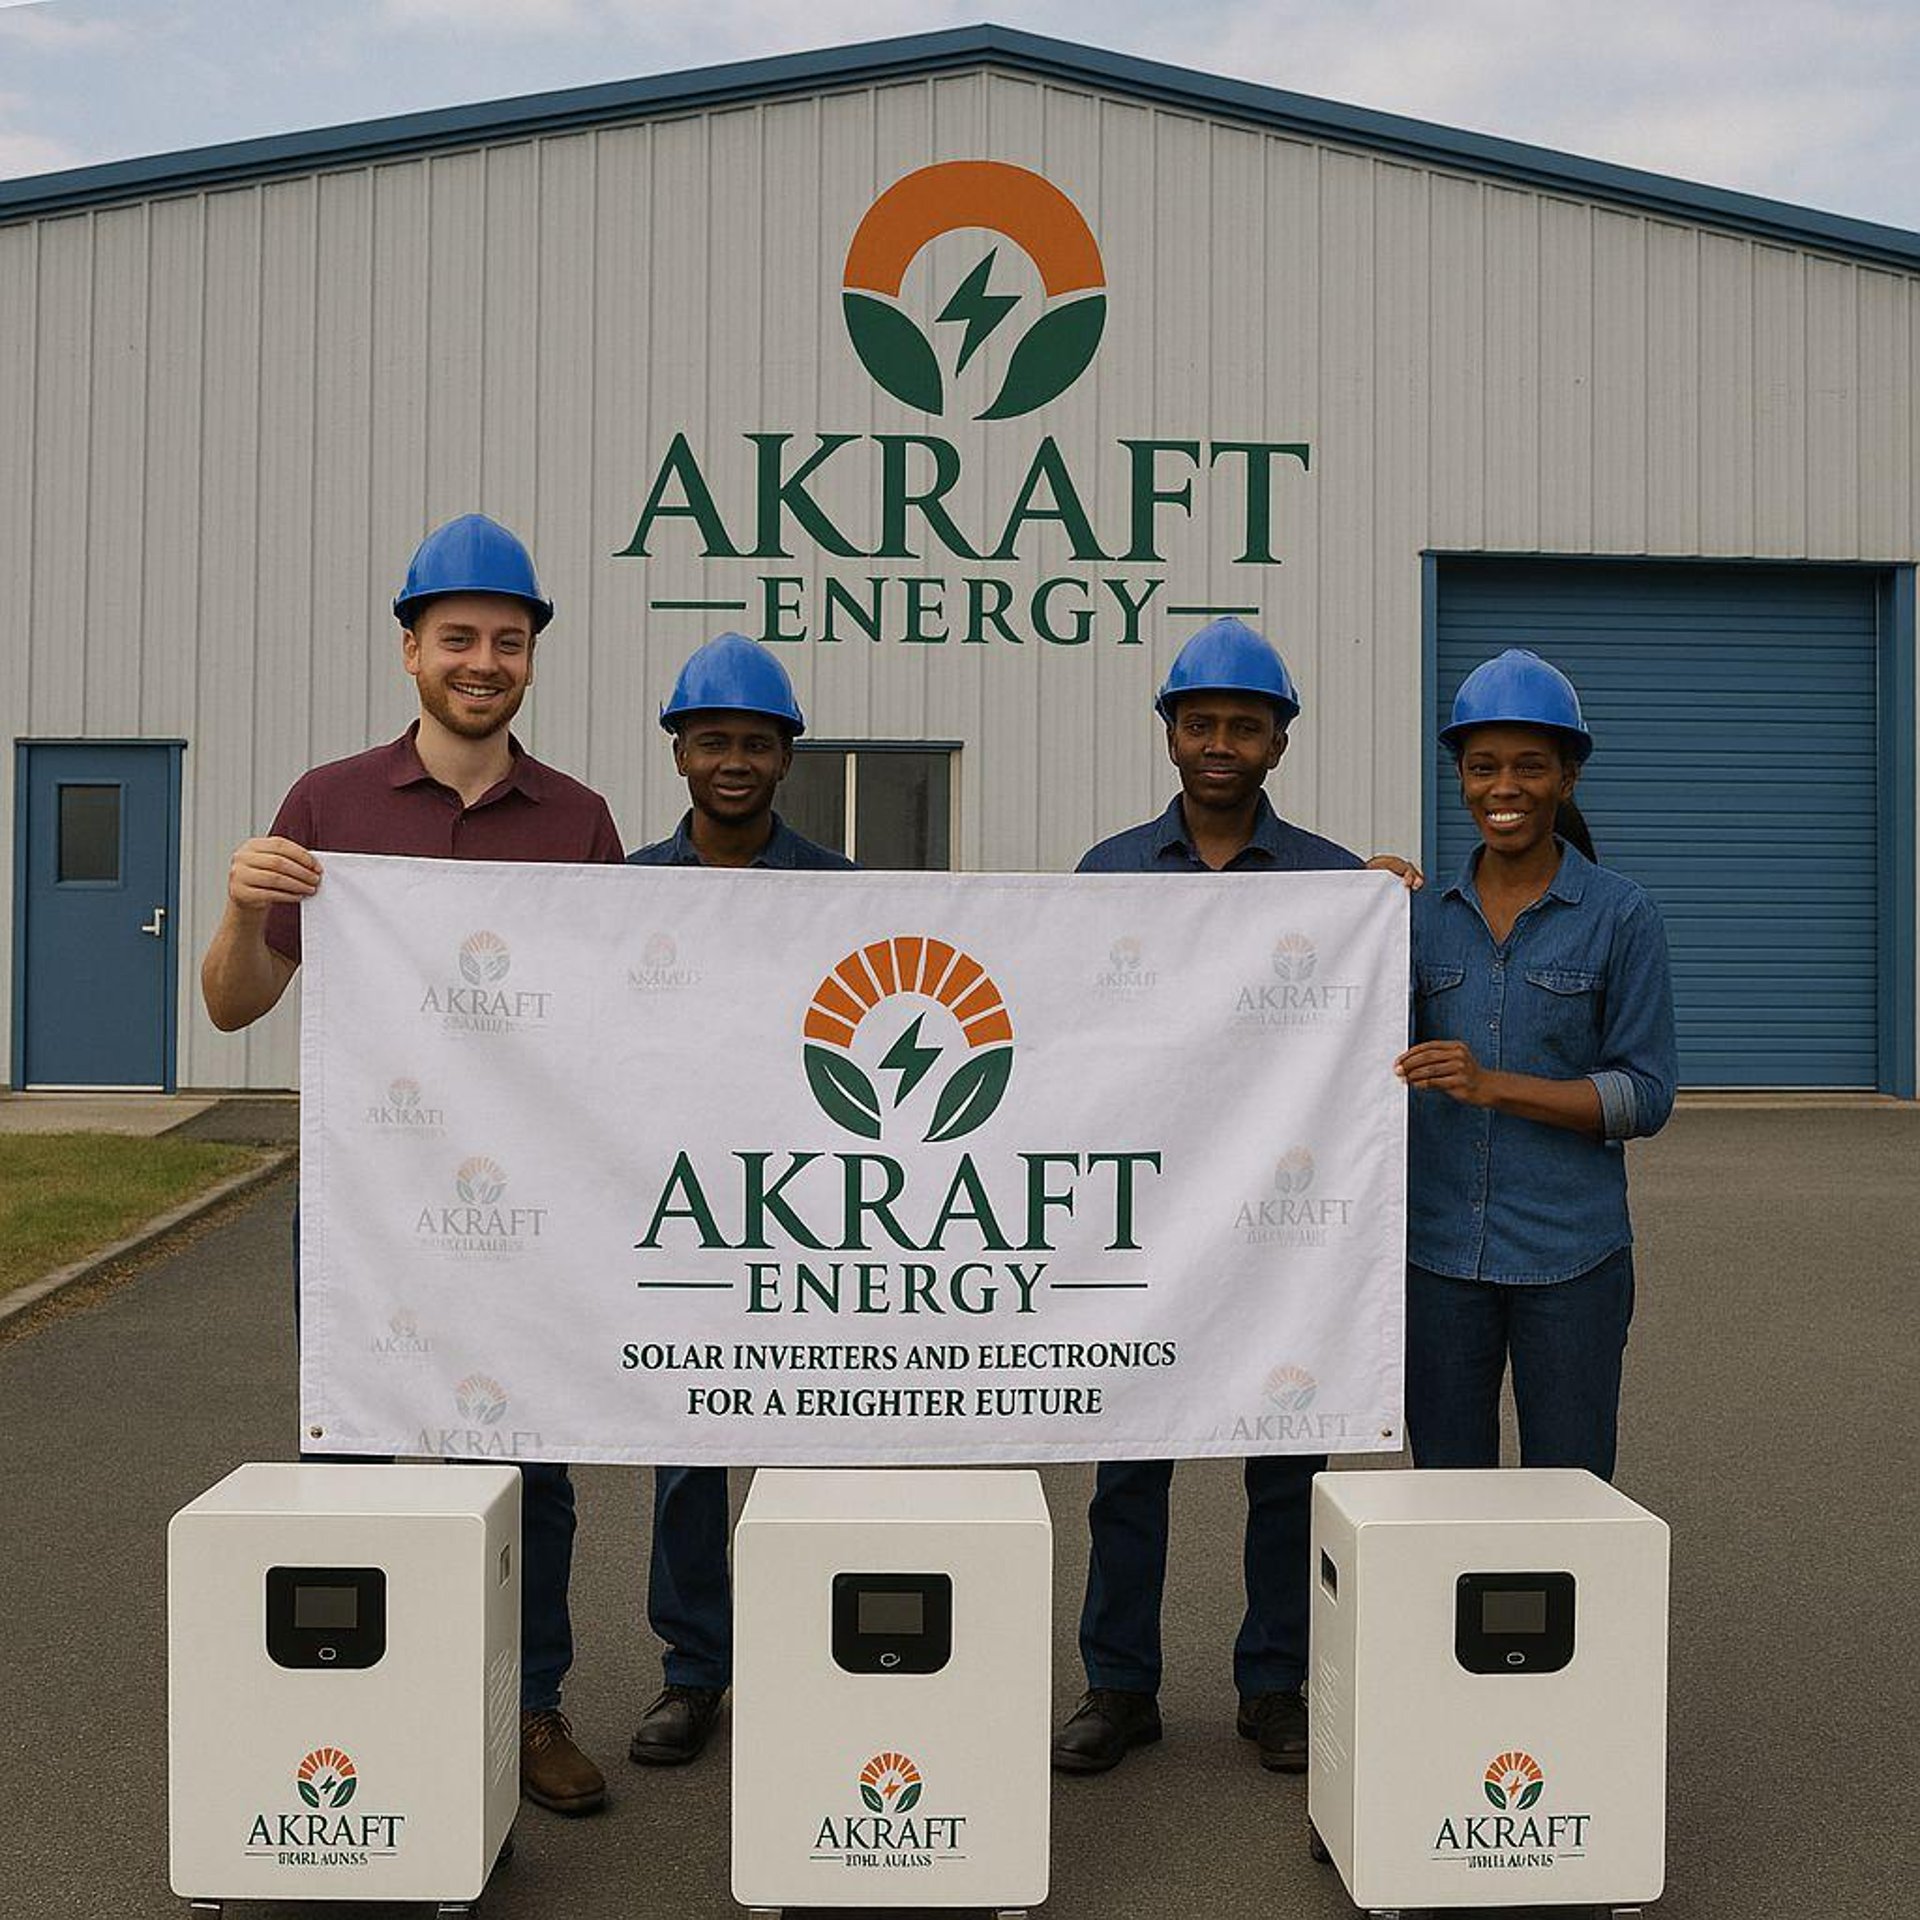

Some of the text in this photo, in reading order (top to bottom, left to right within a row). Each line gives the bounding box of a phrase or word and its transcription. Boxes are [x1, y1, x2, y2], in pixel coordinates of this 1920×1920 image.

[612, 432, 1310, 565] AKRAFT
[757, 576, 1165, 646] ENERGY
[420, 985, 553, 1019] AKRAFT
[1235, 985, 1362, 1012] AKRAFT
[634, 1150, 1162, 1251] AKRAFT
[1233, 1199, 1353, 1229] AKRAFT
[416, 1207, 548, 1237] AKRAFT
[744, 1262, 1051, 1315] ENERGY
[622, 1341, 1177, 1371] SOLAR INVERTERS AND ELECTRONICS
[687, 1387, 1103, 1418] FOR A ERIGHTER EUTURE
[247, 1814, 405, 1848] AKRAFT
[814, 1816, 966, 1849] AKRAFT
[1434, 1815, 1591, 1850] AKRAFT
